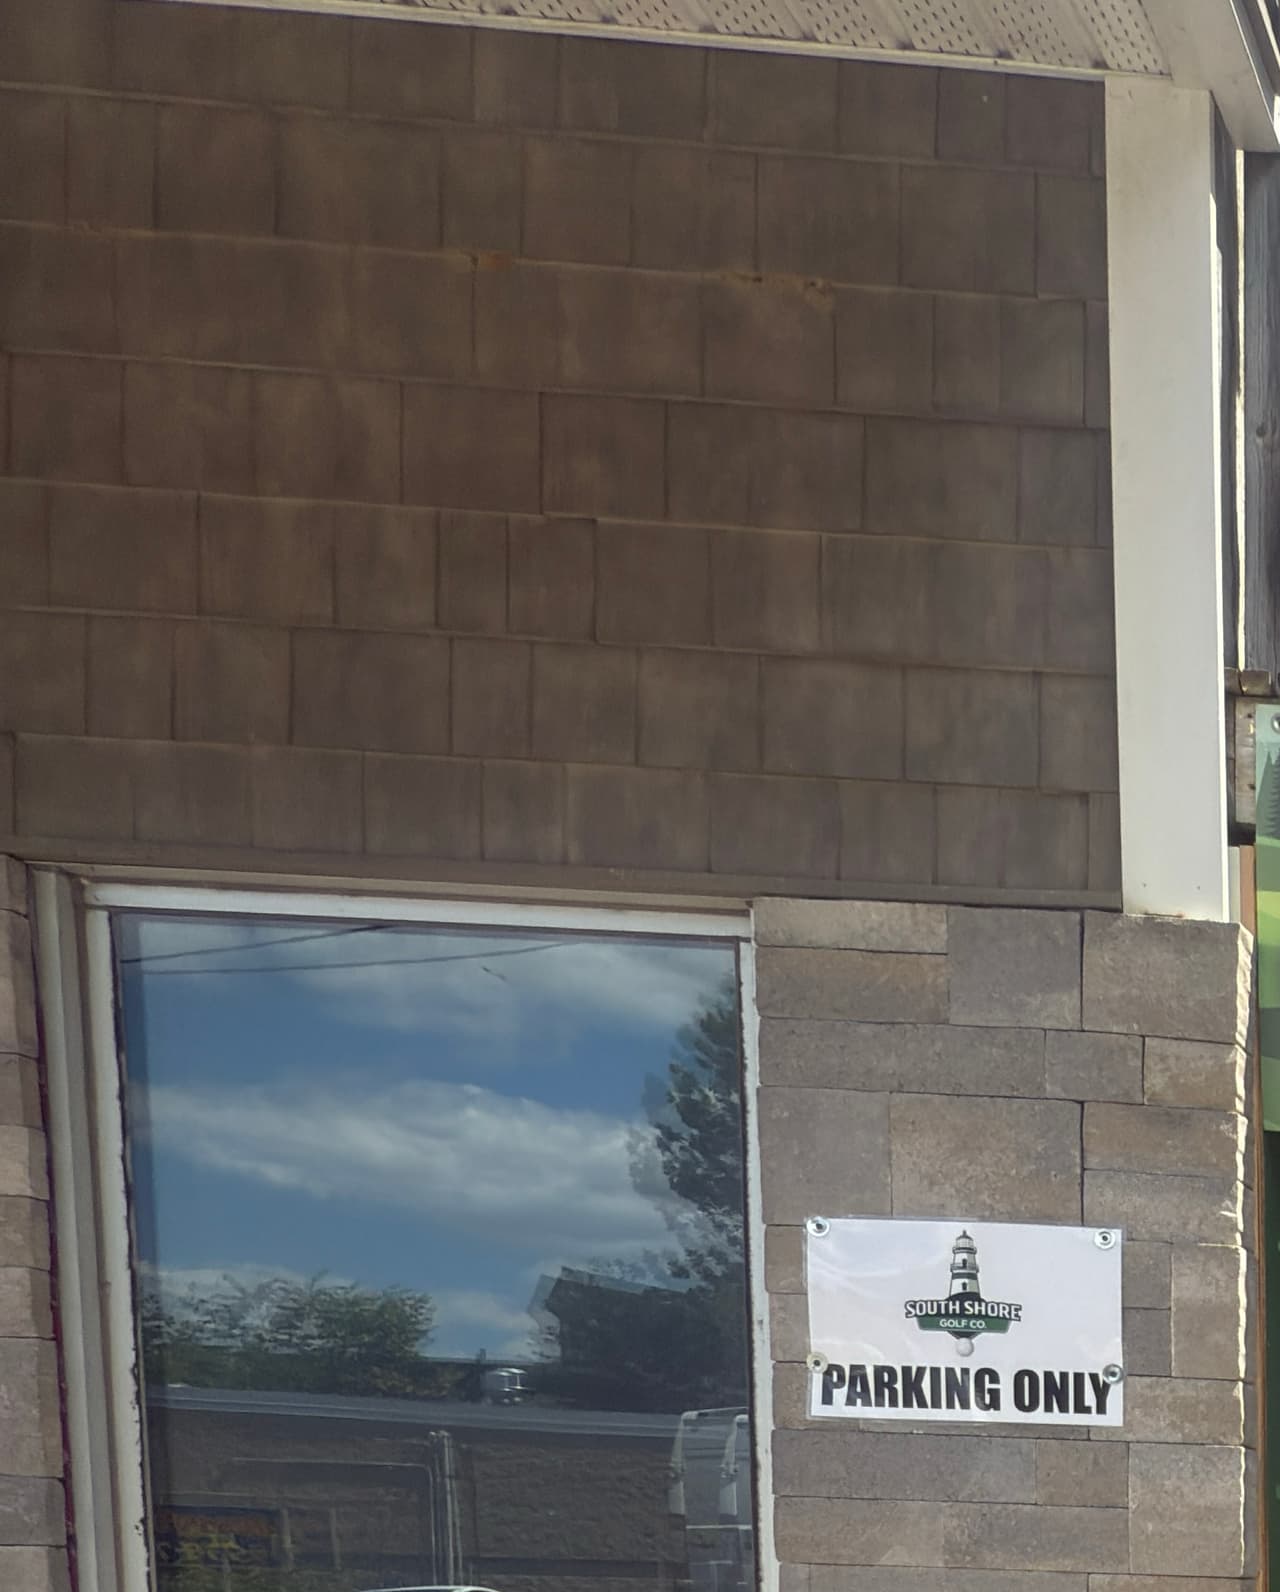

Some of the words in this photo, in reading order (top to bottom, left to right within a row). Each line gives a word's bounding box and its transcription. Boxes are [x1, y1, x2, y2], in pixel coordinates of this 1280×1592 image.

[906, 1300, 961, 1317] SOUTH
[964, 1301, 1022, 1321] SHORE
[939, 1318, 969, 1329] GOLF
[969, 1319, 987, 1330] CO.
[820, 1363, 1002, 1412] PARKING
[1013, 1368, 1113, 1415] ONLY
